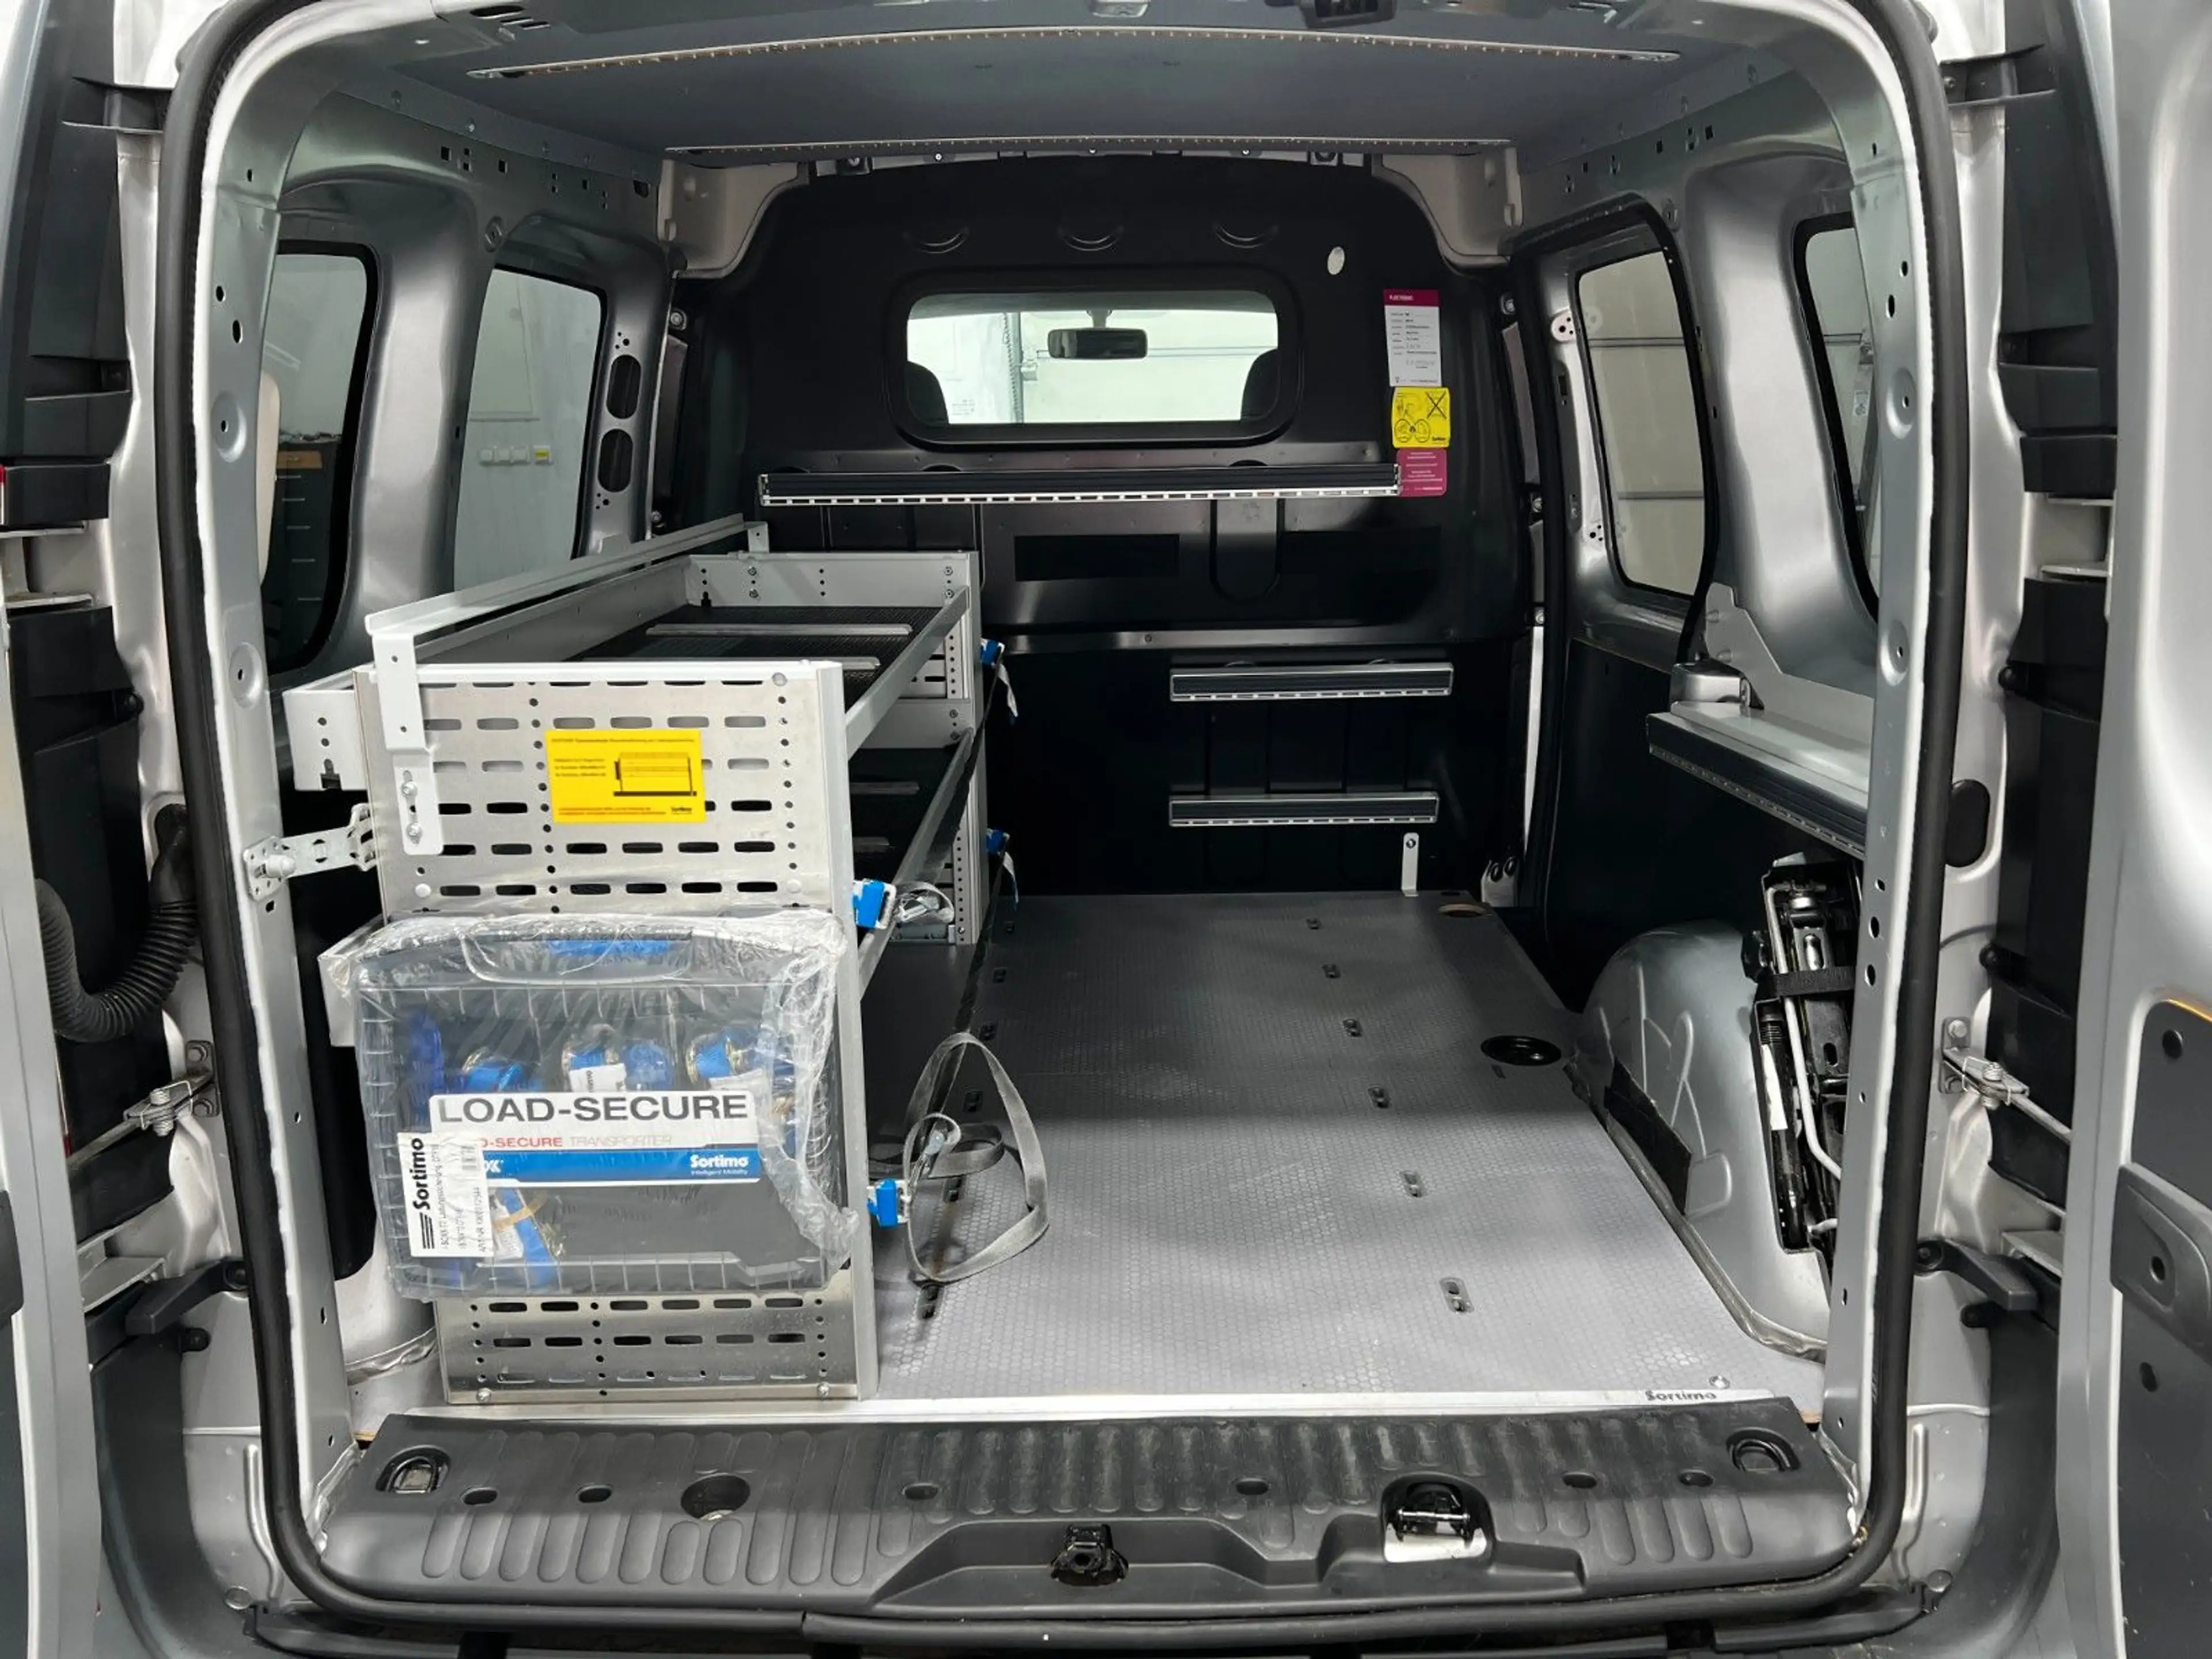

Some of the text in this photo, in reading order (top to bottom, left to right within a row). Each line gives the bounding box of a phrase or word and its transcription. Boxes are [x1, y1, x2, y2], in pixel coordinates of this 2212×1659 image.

[438, 1094, 748, 1123] LOAD-SECURE
[570, 1135, 672, 1146] TRANSPORTER
[690, 1154, 749, 1168] Sortimo
[410, 1138, 431, 1210] Sortimo
[1645, 1389, 1717, 1402] Sortimo
